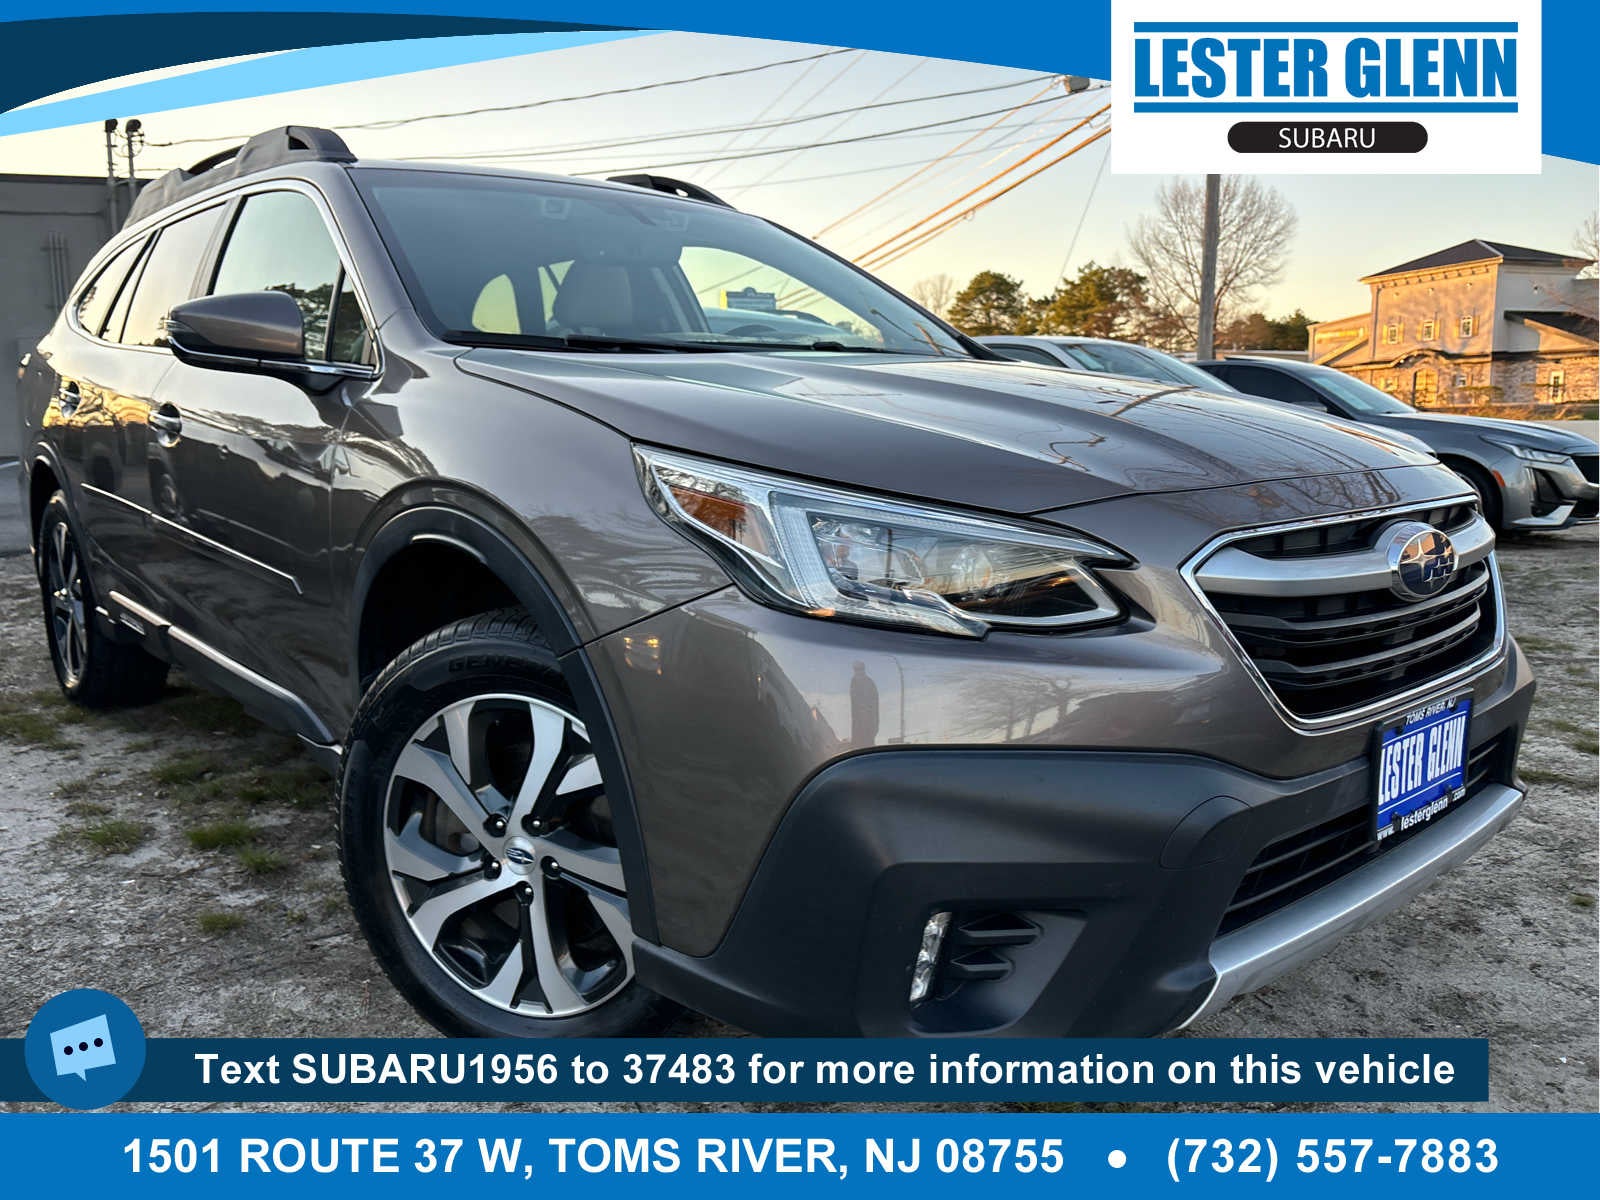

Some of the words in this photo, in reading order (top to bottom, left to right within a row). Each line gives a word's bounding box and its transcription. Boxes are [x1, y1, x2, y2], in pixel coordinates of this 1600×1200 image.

[1405, 706, 1427, 726] TOMS
[1378, 732, 1425, 806] LESTER
[1427, 715, 1466, 782] GLENN
